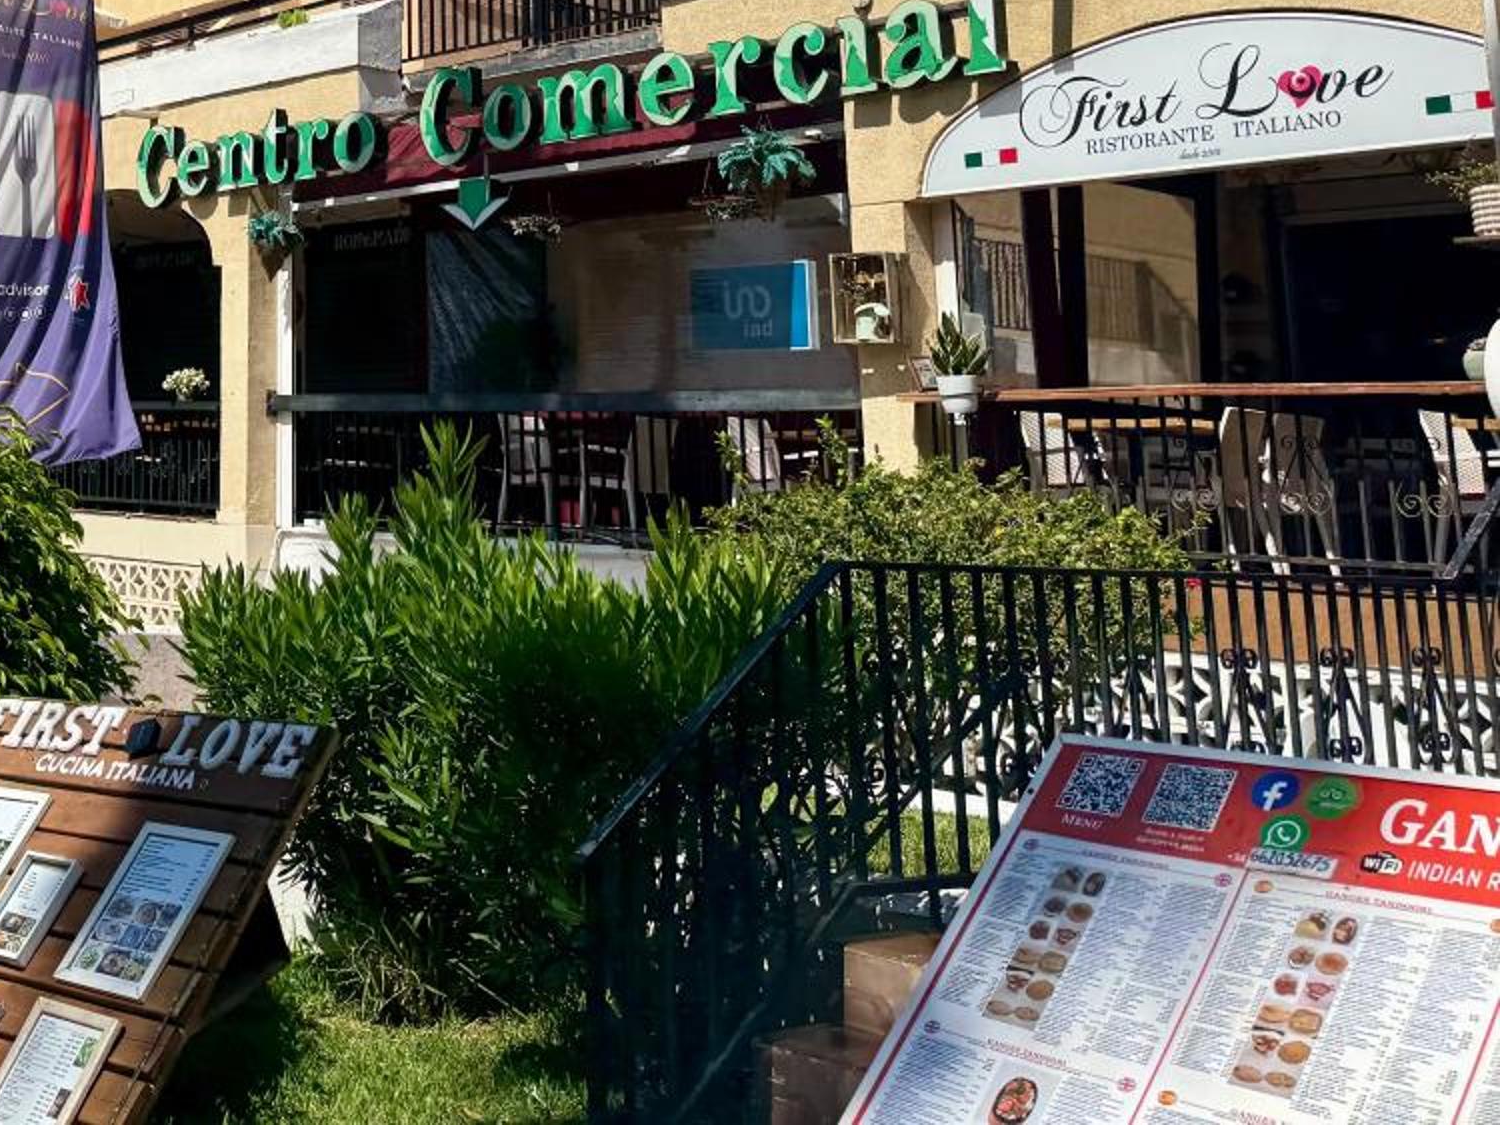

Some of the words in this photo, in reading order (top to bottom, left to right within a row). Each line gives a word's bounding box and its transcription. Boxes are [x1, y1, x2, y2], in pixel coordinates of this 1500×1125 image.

[1019, 75, 1183, 148] First
[1195, 42, 1395, 120] Love
[1085, 124, 1215, 156] RISTORANTE
[1232, 109, 1342, 139] ITALIANO
[135, 107, 384, 209] Centro
[159, 715, 319, 779] LOVE
[35, 754, 103, 778] CUCINA
[105, 761, 197, 790] ITALIANA
[1061, 812, 1103, 828] MENU
[1406, 859, 1483, 889] INDIAN
